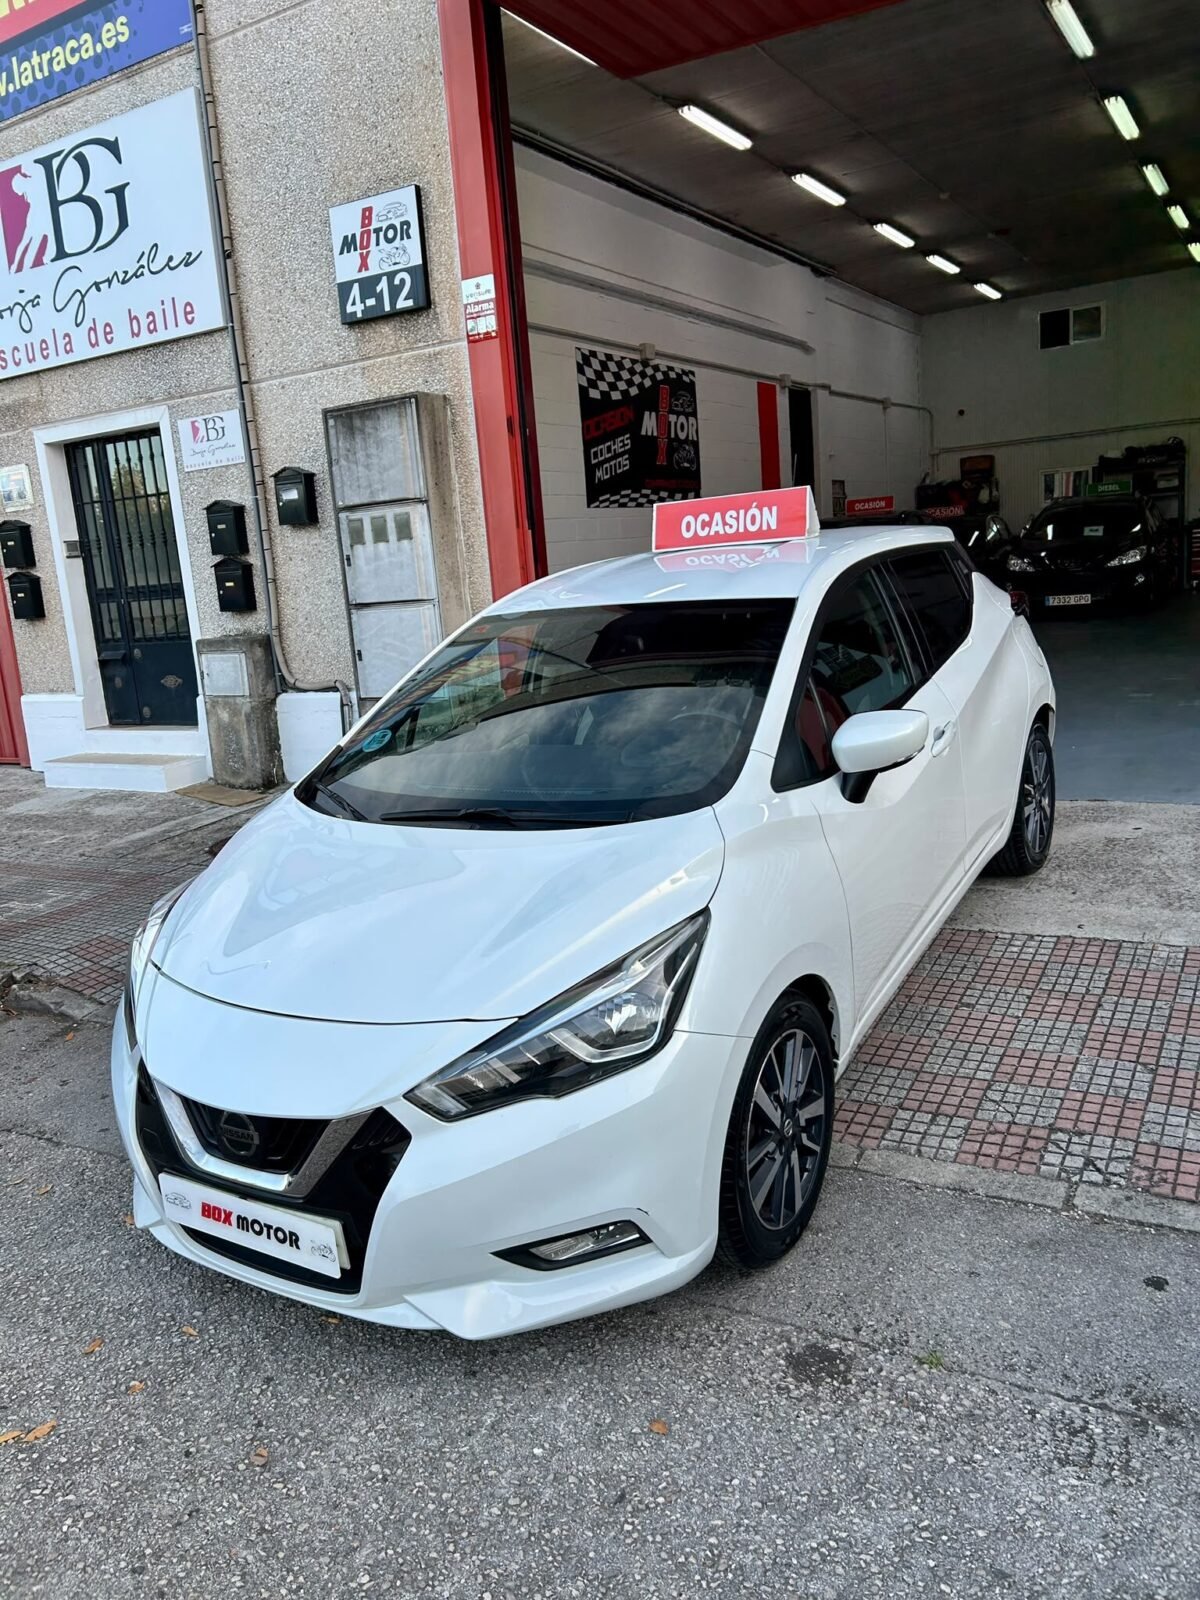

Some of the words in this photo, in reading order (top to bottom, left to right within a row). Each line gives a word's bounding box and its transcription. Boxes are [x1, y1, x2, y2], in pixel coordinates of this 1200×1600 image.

[53, 243, 203, 327] González
[346, 271, 414, 318] 4-12
[87, 317, 114, 348] de
[128, 297, 196, 338] baile
[466, 302, 494, 315] Alarma
[590, 433, 631, 465] COCHES
[595, 454, 630, 485] MOTOS
[681, 502, 778, 539] OCASIÓN
[1051, 596, 1072, 605] 7332
[201, 1201, 234, 1227] BOX
[236, 1213, 301, 1250] MOTOR
